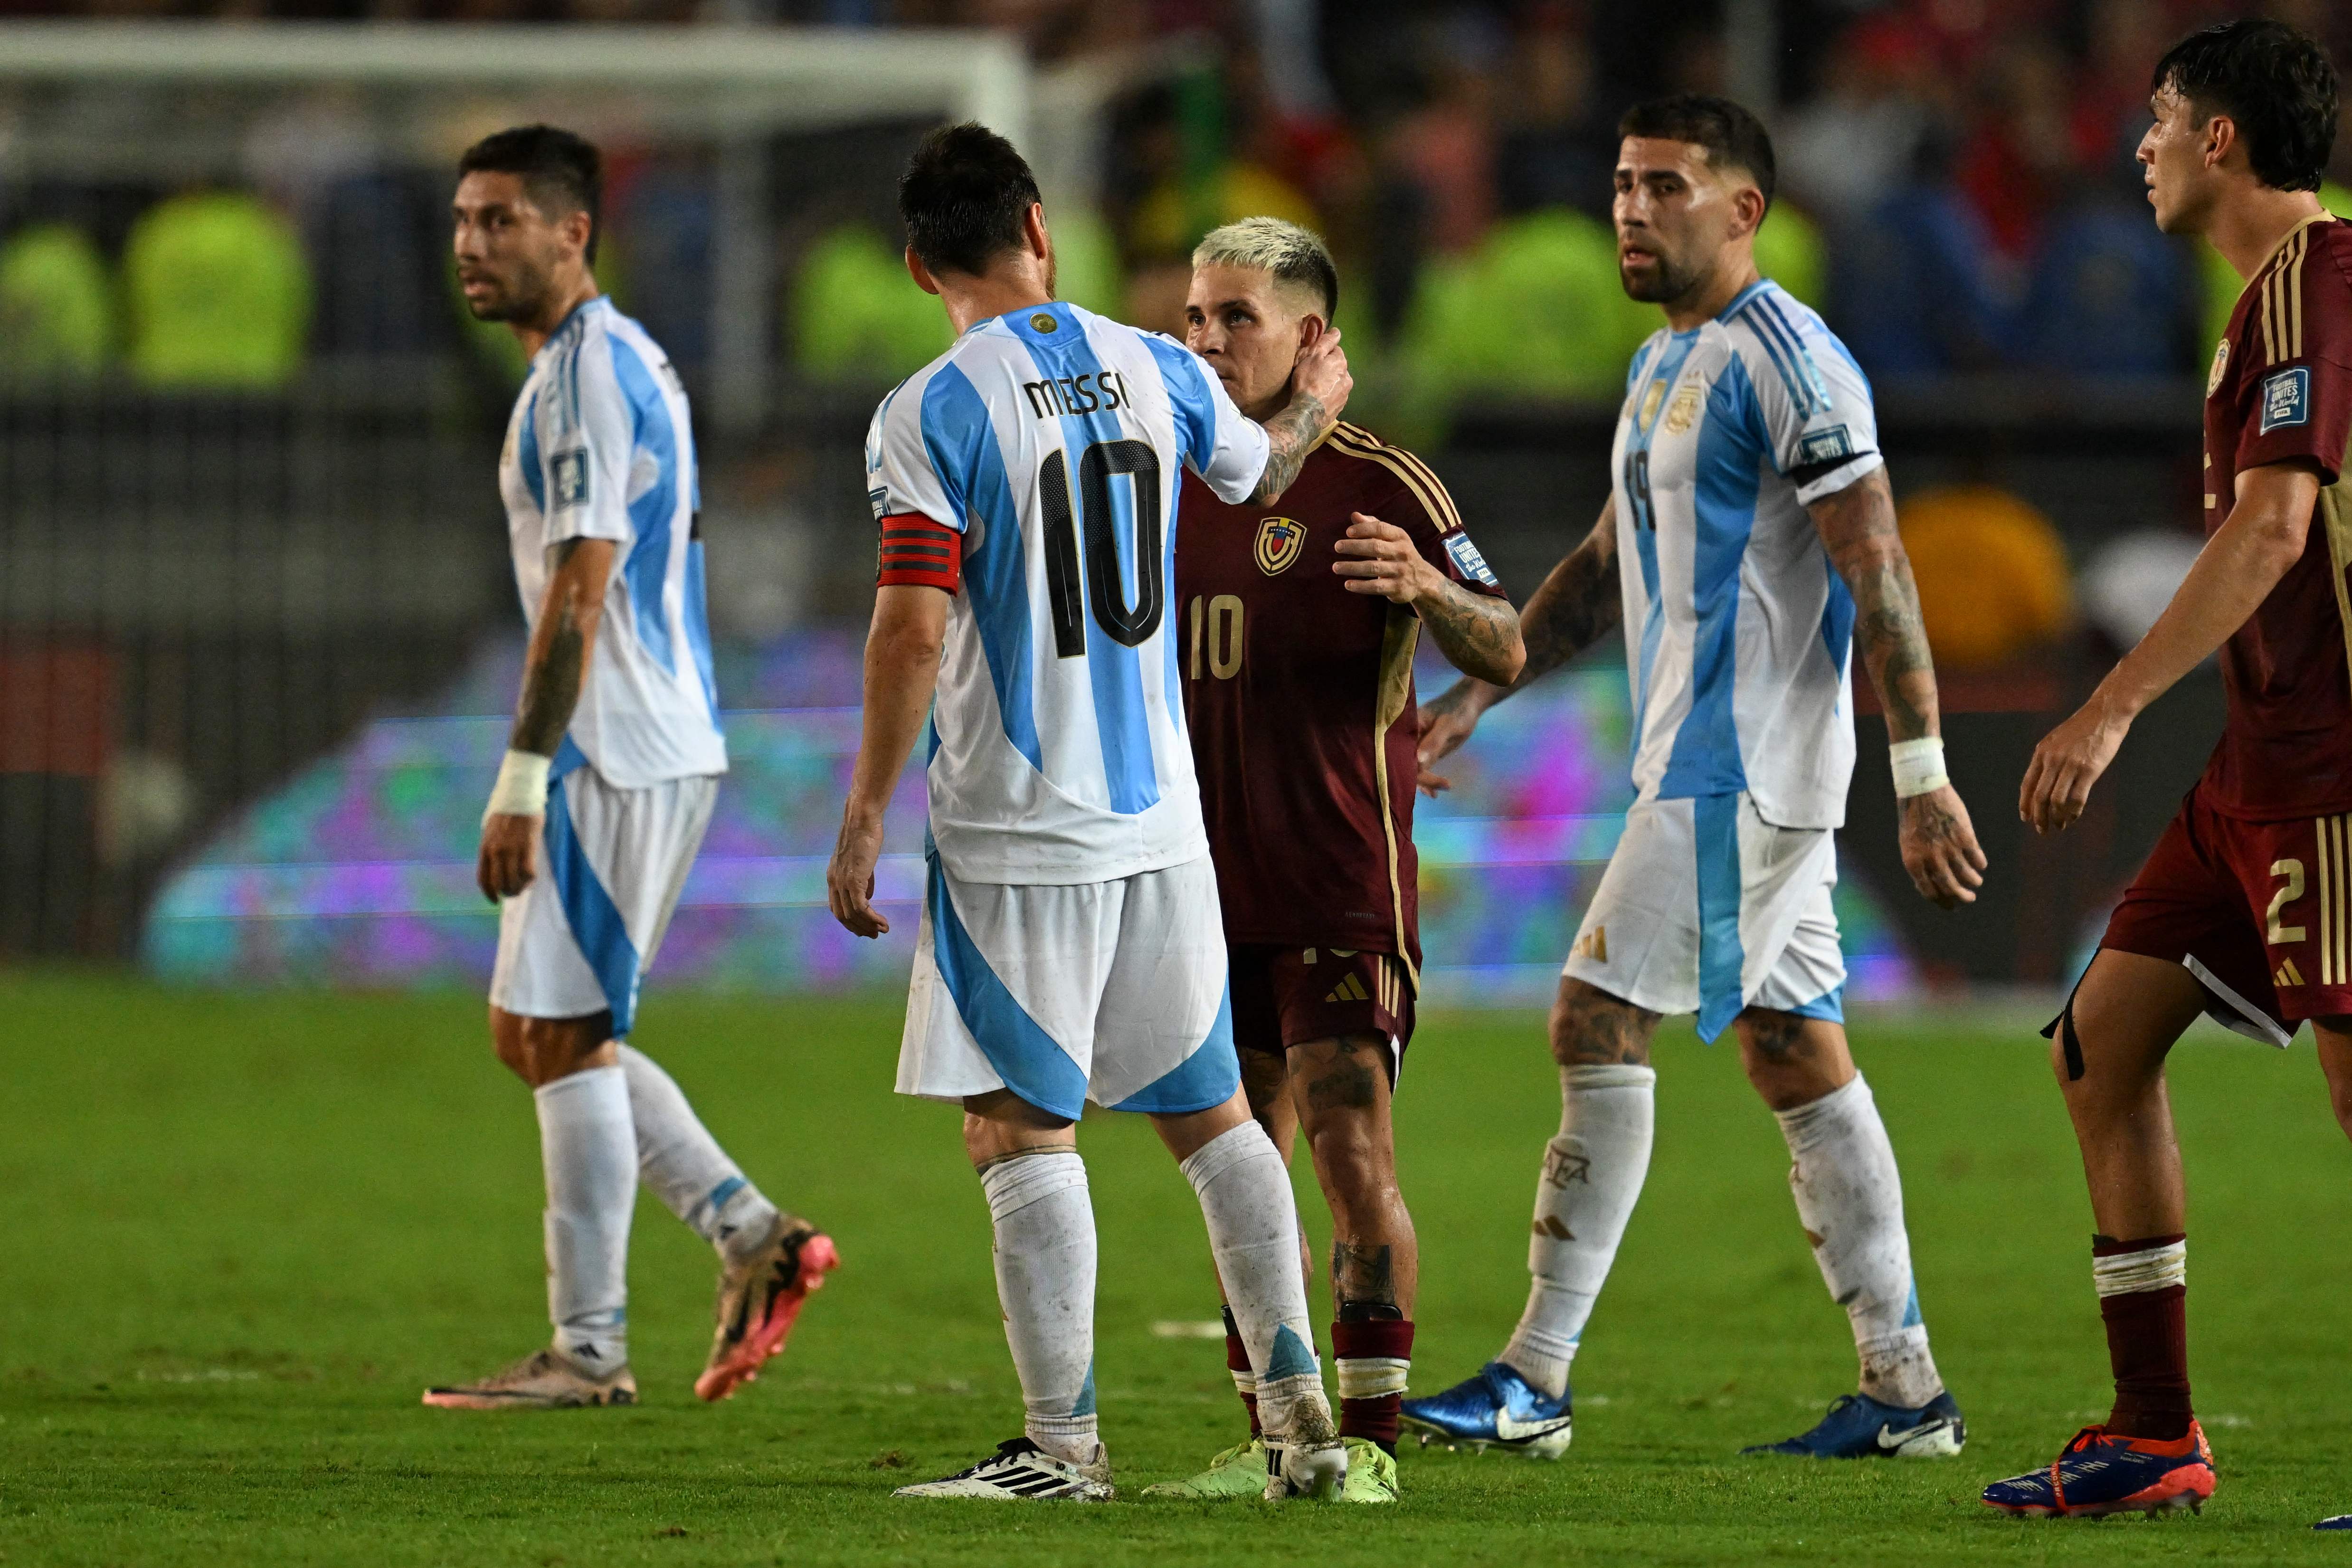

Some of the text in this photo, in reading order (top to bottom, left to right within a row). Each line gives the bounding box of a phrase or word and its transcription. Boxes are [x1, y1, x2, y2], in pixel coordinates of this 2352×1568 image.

[1023, 371, 1130, 419] MESSI
[2272, 377, 2298, 392] FOOTBALL
[2272, 385, 2297, 402] UNITES
[1625, 449, 1656, 531] 19
[1039, 440, 1165, 659] 10
[1466, 562, 1476, 572] the
[1191, 595, 1243, 680] 10
[2267, 858, 2305, 945] 2
[1055, 1461, 1065, 1471] 10
